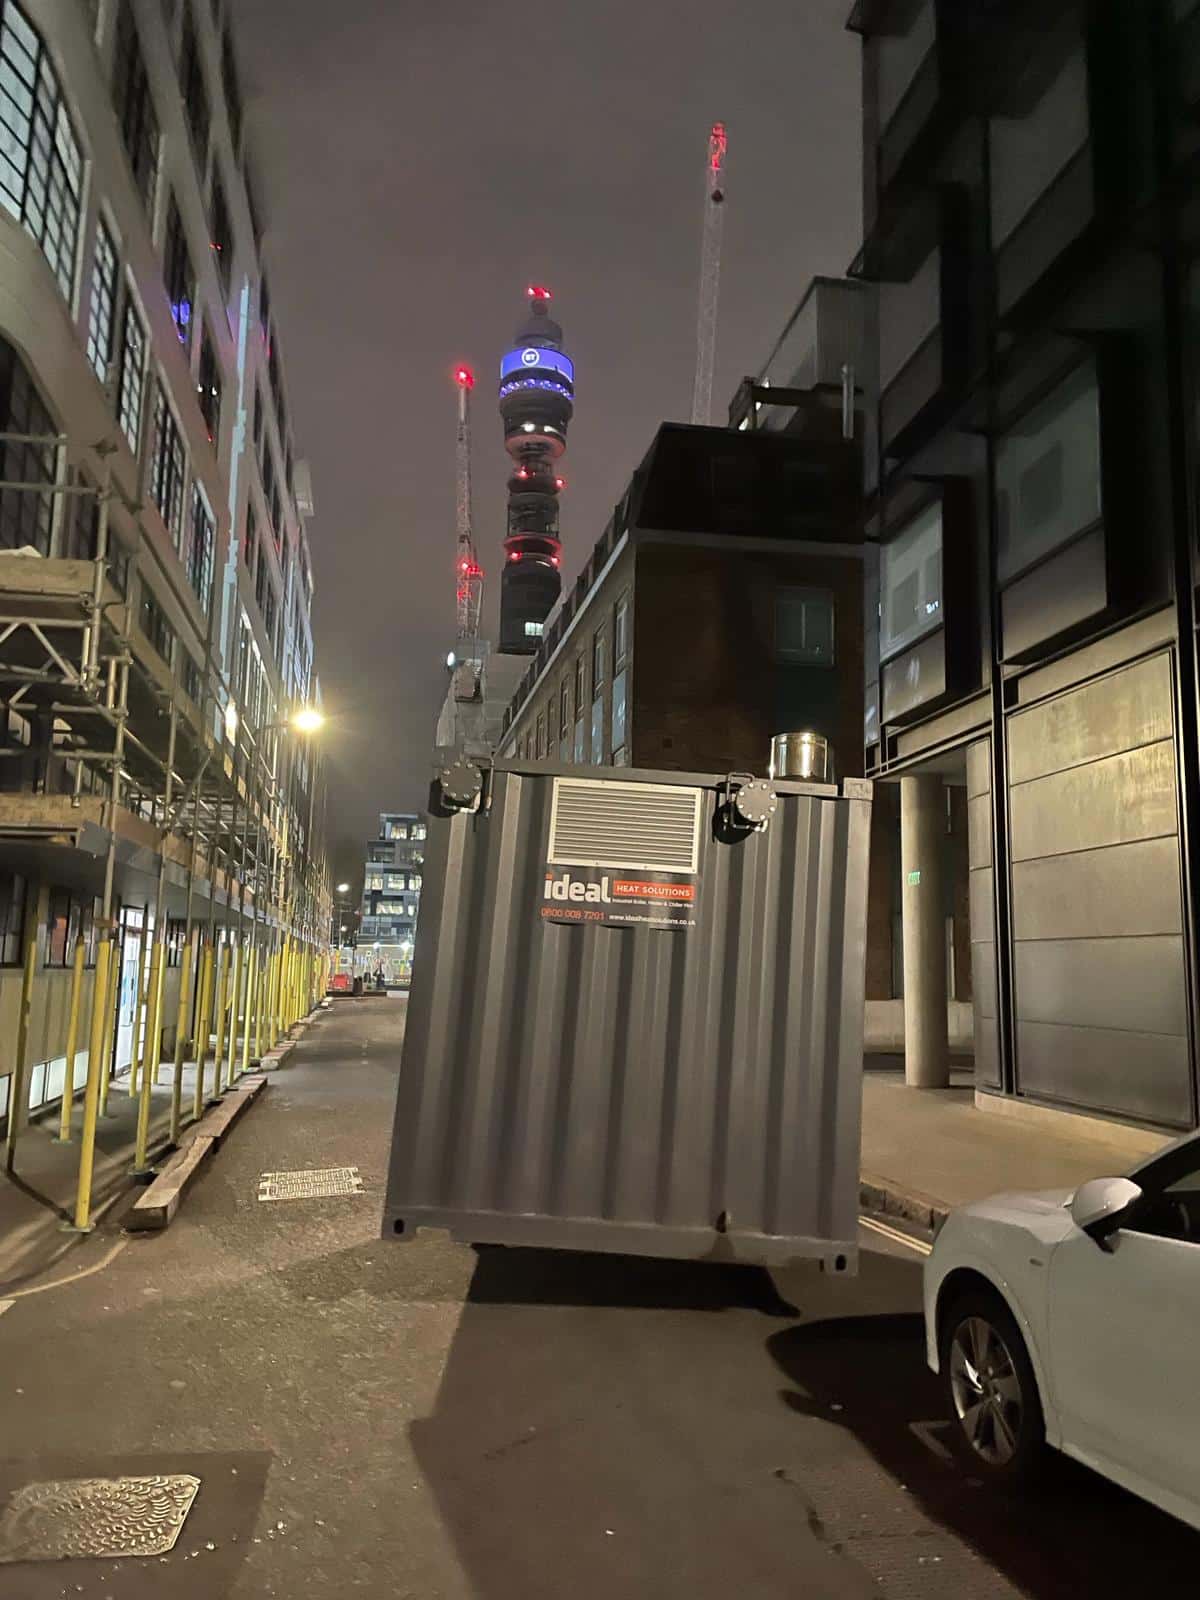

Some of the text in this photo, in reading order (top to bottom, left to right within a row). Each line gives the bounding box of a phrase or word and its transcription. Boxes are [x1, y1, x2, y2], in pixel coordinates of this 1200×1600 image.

[544, 871, 611, 903] ideal
[616, 884, 690, 897] HEAT SOLUTIONS
